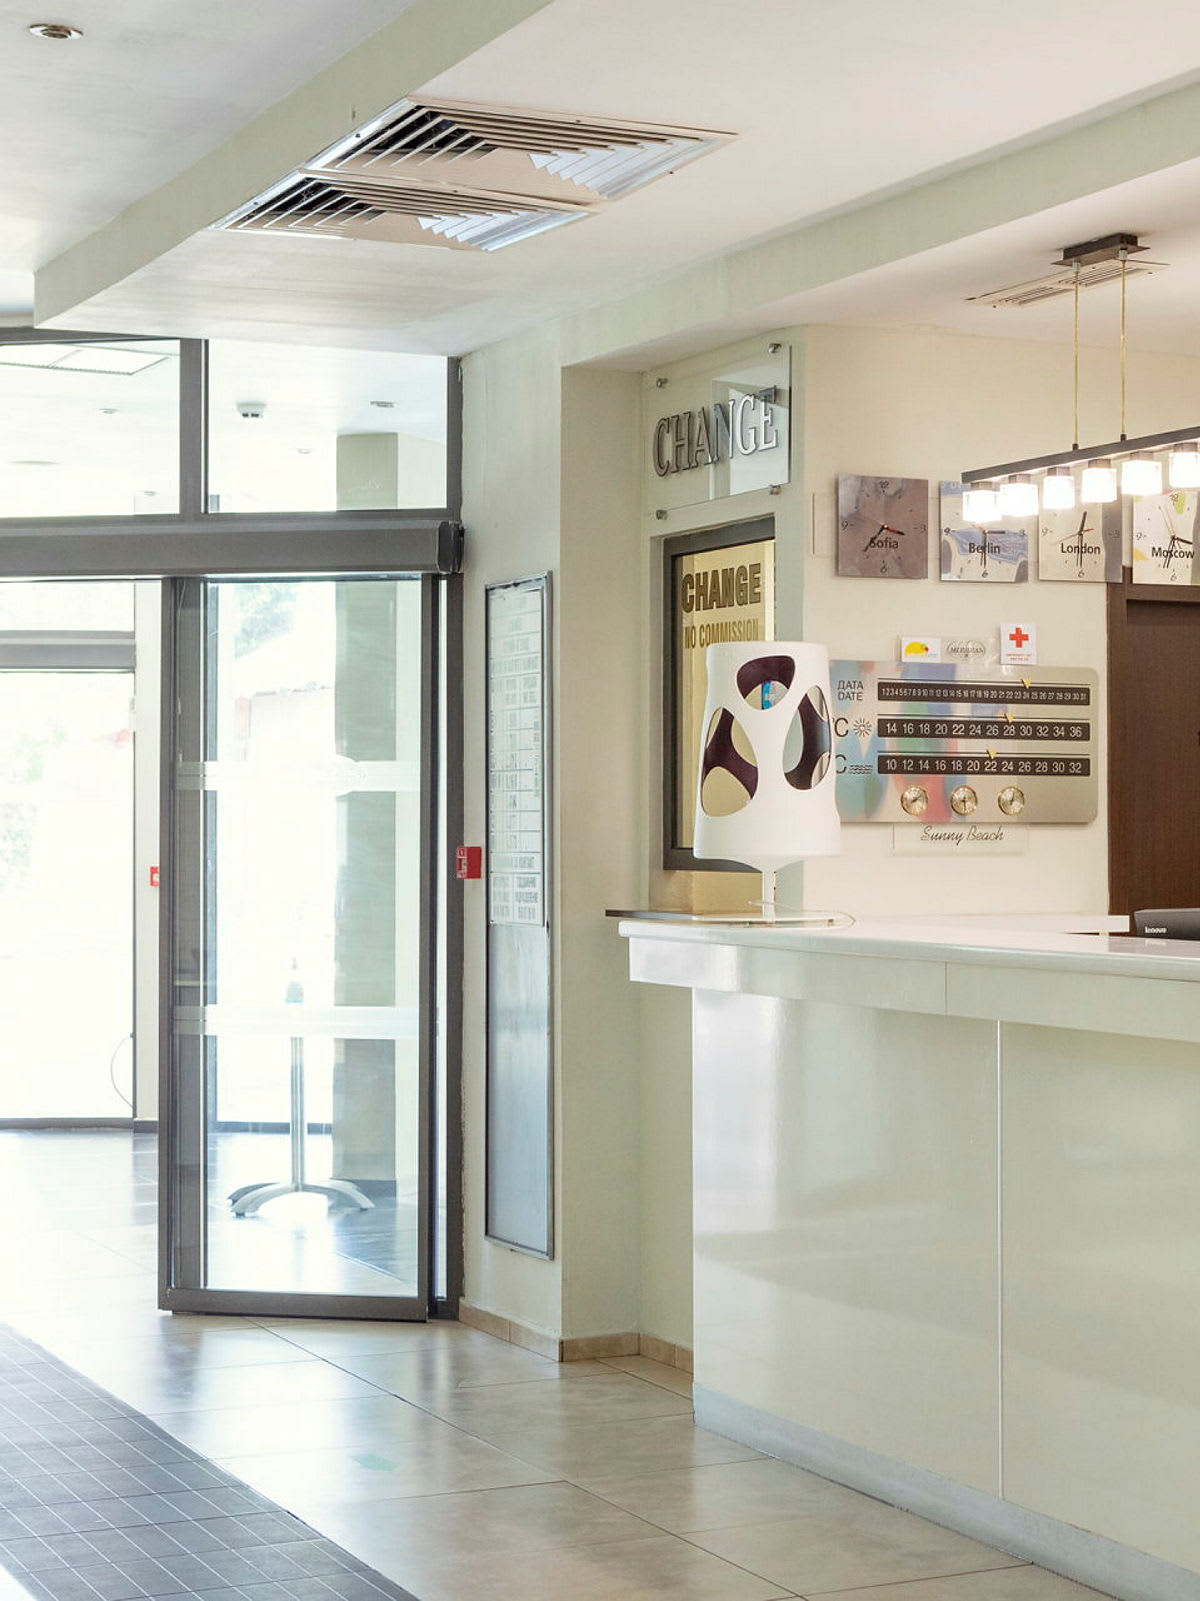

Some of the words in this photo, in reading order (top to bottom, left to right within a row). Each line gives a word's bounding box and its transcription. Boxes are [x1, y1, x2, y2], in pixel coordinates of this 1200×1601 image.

[653, 385, 778, 477] CHANGE
[1061, 543, 1101, 555] London
[1151, 547, 1195, 559] Moscow
[881, 565, 887, 573] 6
[982, 569, 988, 578] 6
[1078, 569, 1084, 578] 6
[682, 563, 761, 613] CHANGE
[684, 625, 696, 649] NO
[699, 619, 759, 648] COMMISSION
[837, 680, 864, 690] ДАТА
[837, 691, 864, 701] DATE
[887, 723, 897, 734] 14
[903, 723, 914, 734] 16
[919, 723, 929, 734] 18
[935, 723, 948, 735] 20
[952, 724, 964, 735] 22
[969, 724, 981, 736] 24
[986, 724, 999, 736] 26
[1003, 725, 1015, 736] 28
[1020, 725, 1032, 736] 30
[1036, 725, 1049, 737] 32
[1053, 726, 1065, 737] 34
[1070, 726, 1082, 737] 36
[887, 759, 897, 770] 10
[903, 759, 913, 770] 12
[919, 759, 929, 770] 14
[935, 760, 946, 771] 16
[951, 760, 963, 771] 18
[967, 760, 980, 771] 20
[984, 761, 997, 772] 22
[1002, 761, 1014, 772] 24
[1018, 761, 1031, 772] 26
[1035, 761, 1048, 773] 28
[1052, 762, 1065, 773] 30
[1069, 762, 1082, 773] 32
[920, 824, 964, 846] Sunny
[966, 824, 1004, 841] Beach
